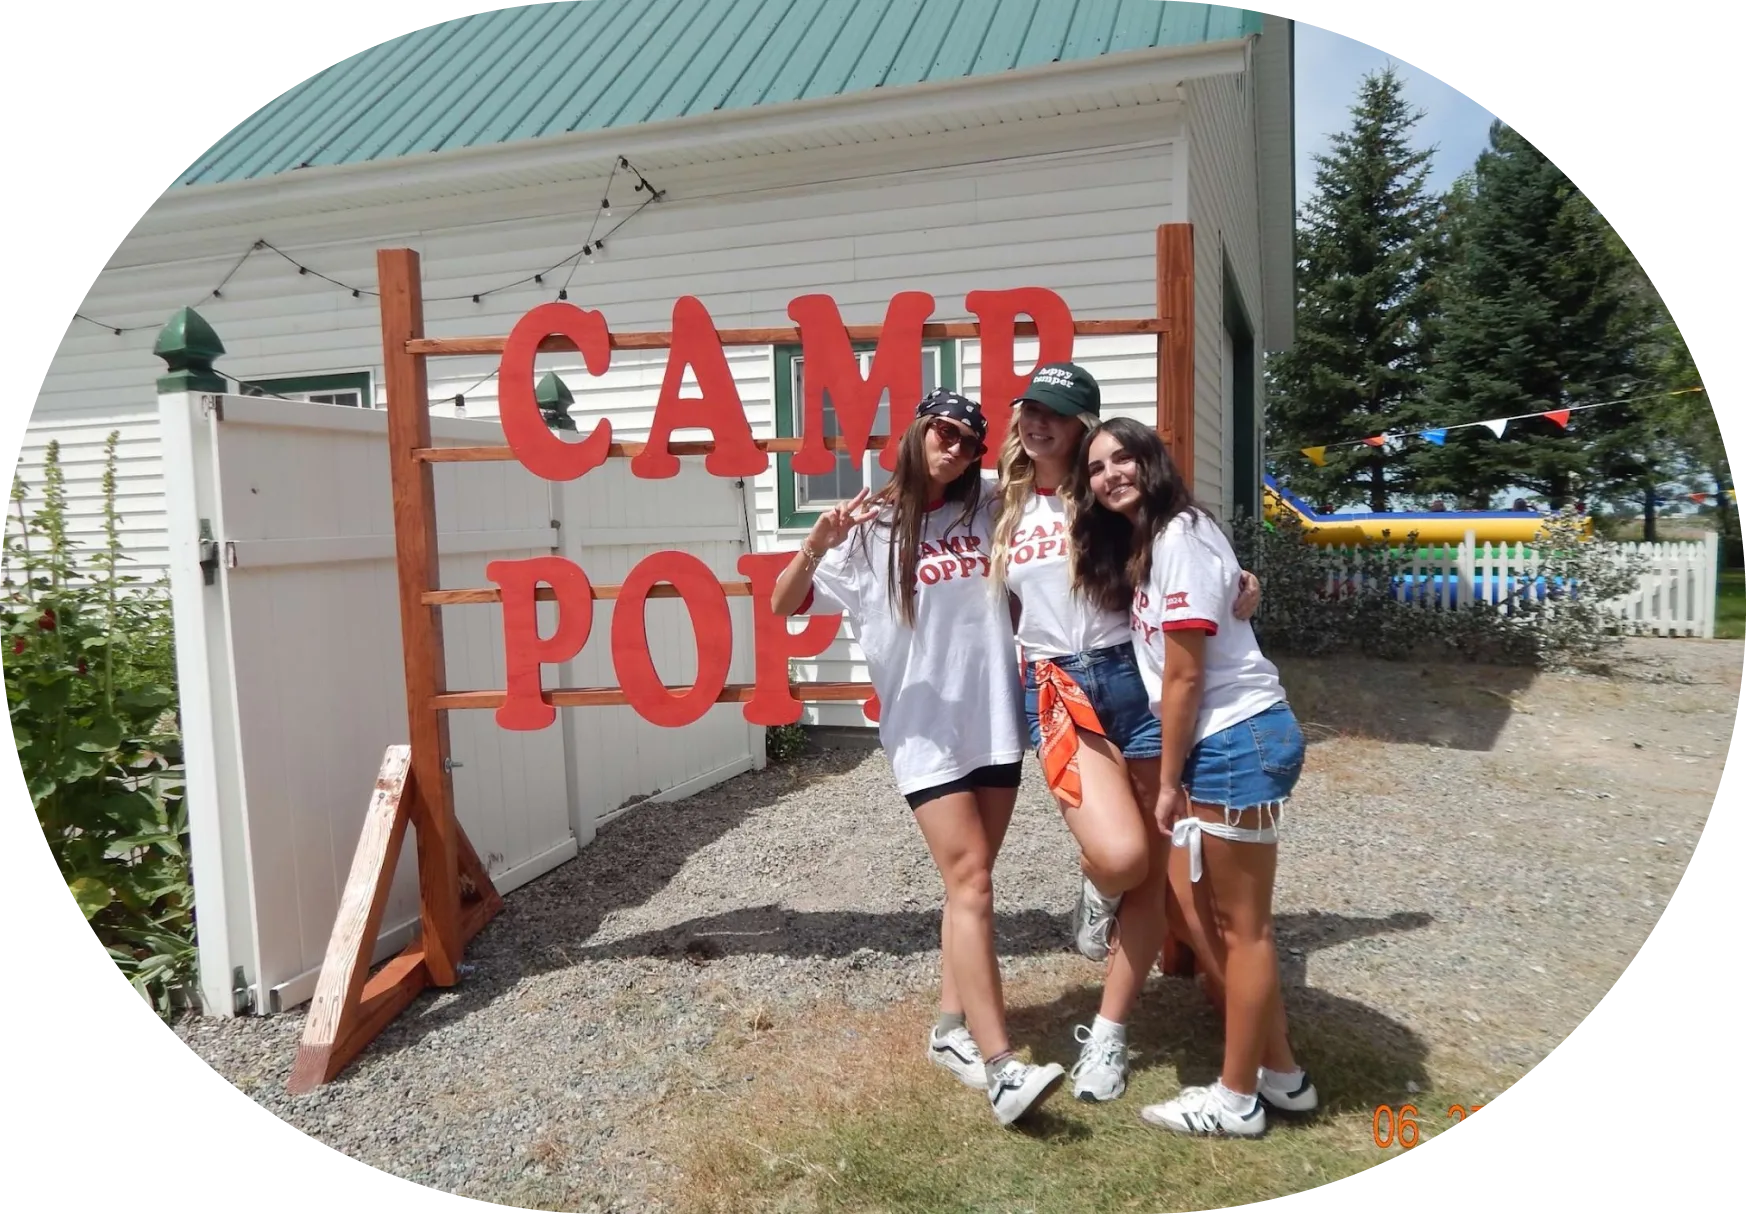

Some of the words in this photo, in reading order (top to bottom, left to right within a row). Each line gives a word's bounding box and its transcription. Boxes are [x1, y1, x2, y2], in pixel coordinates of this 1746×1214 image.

[498, 287, 1074, 481] CAMP
[919, 536, 981, 559] AMP
[486, 550, 882, 731] POP
